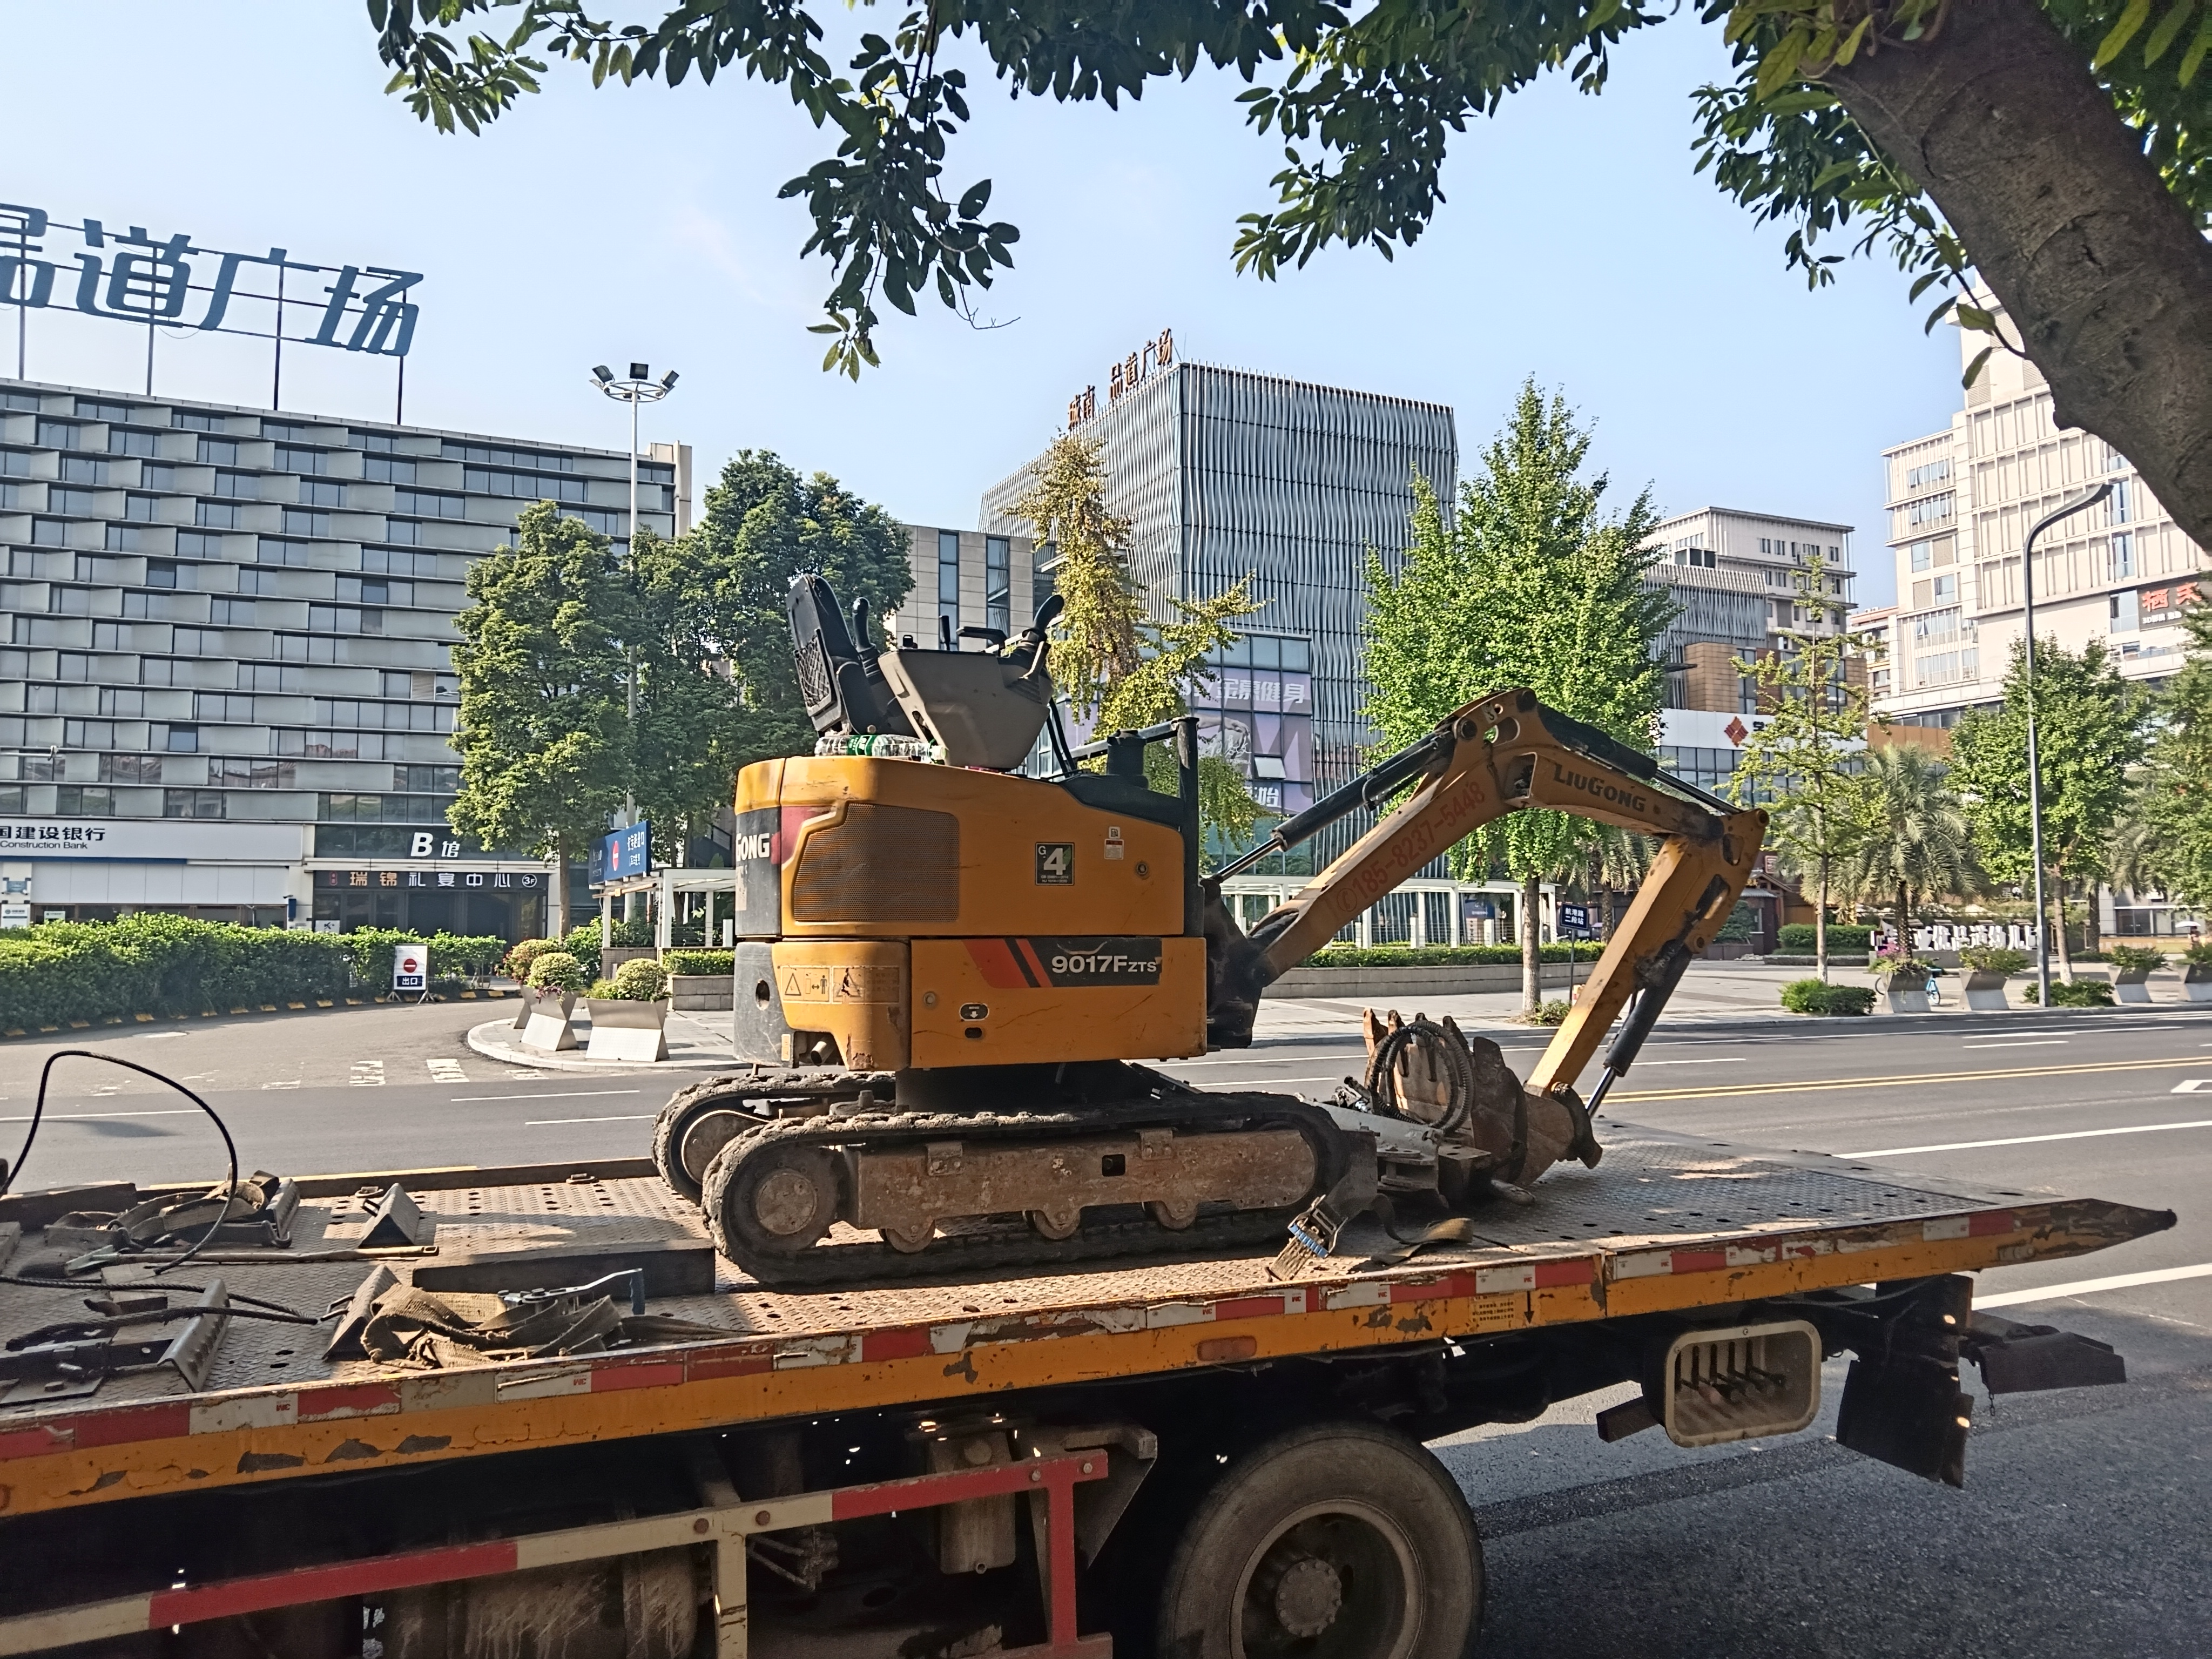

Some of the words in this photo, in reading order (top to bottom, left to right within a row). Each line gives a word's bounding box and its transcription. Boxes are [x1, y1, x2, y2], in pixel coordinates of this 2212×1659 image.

[0, 840, 60, 848] Construction
[410, 832, 433, 857] B
[441, 840, 460, 858] 馆
[1353, 781, 1485, 899] 185-8237-5448
[1043, 847, 1067, 875] 4
[349, 871, 511, 888] 瑞锦礼宴中心
[523, 876, 536, 885] 3F
[402, 976, 418, 986] 出口
